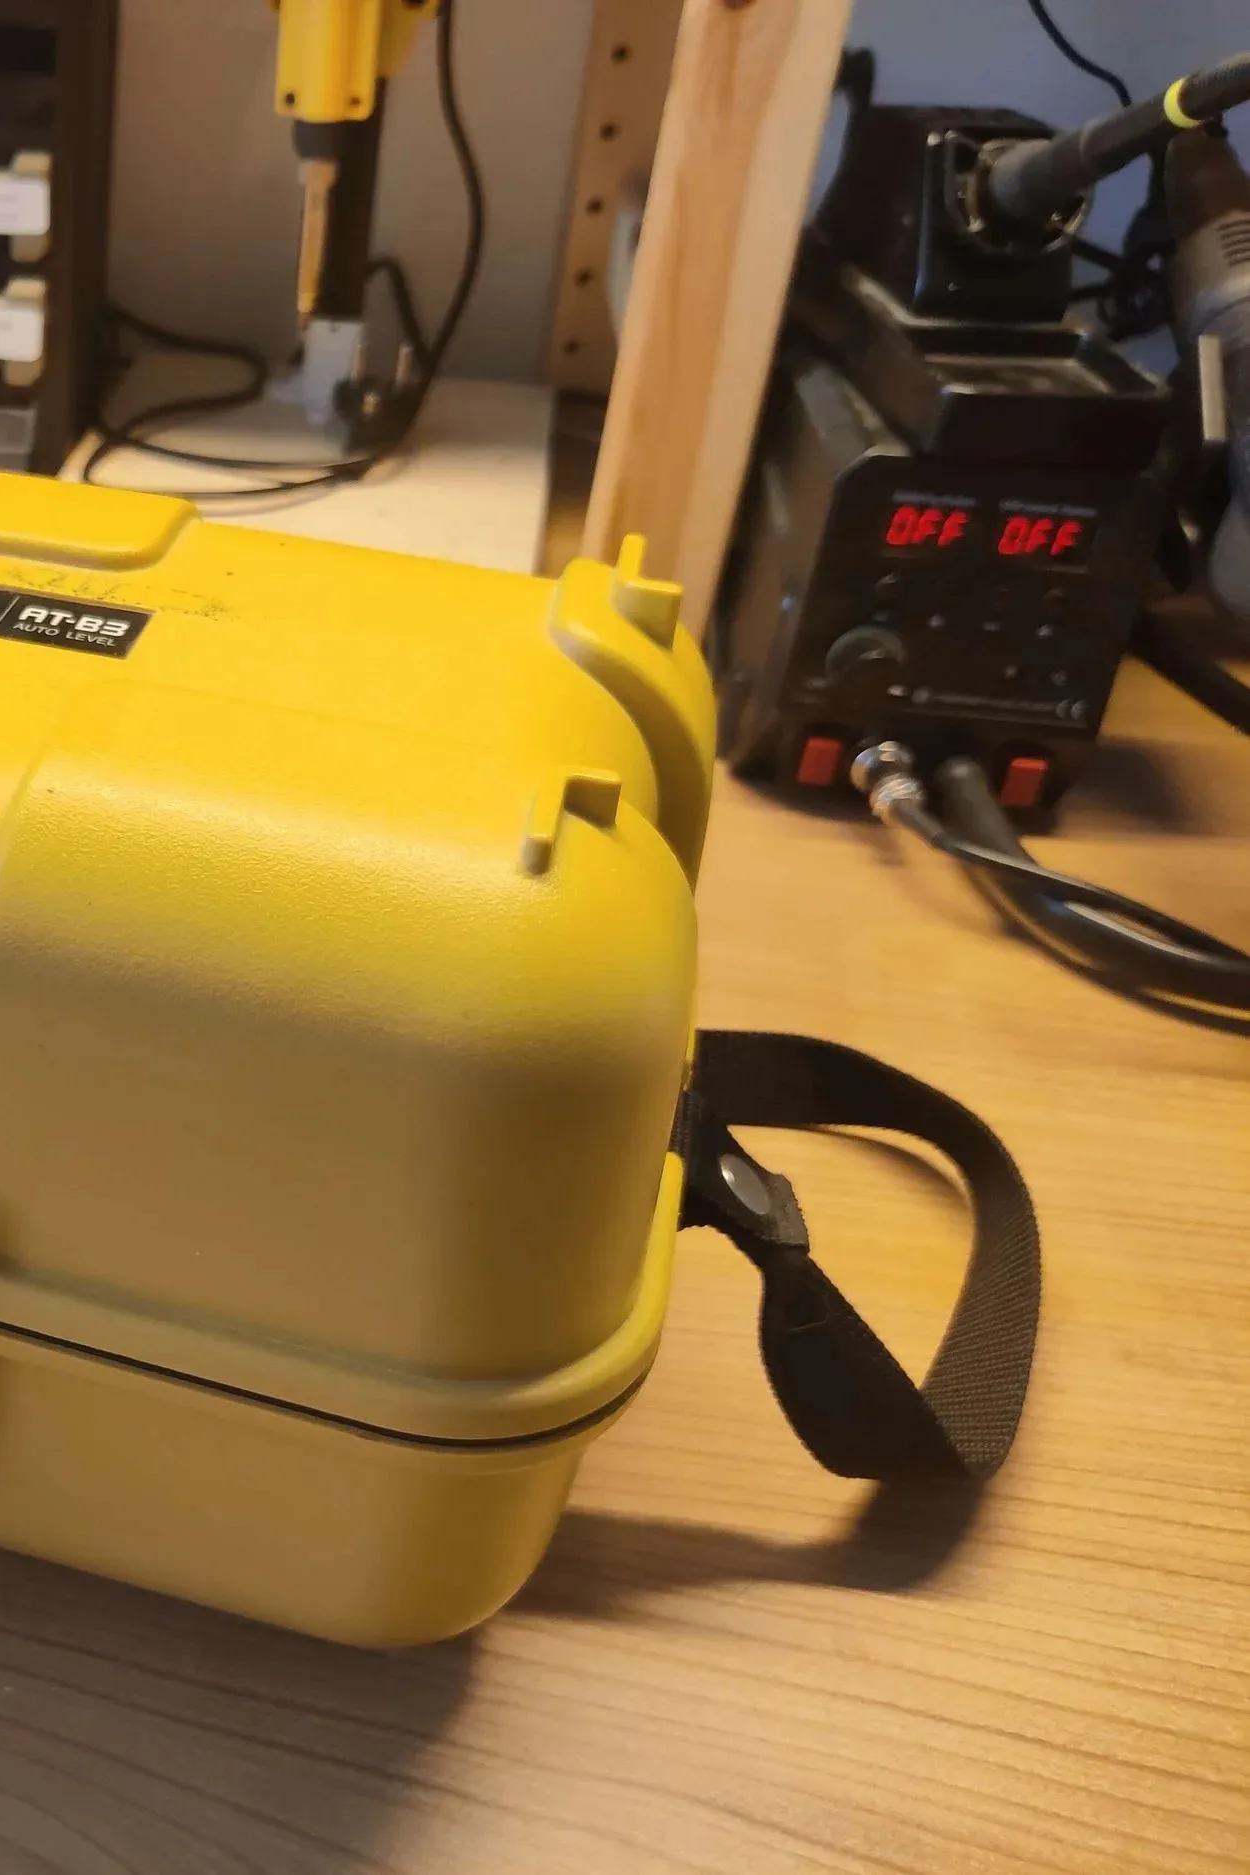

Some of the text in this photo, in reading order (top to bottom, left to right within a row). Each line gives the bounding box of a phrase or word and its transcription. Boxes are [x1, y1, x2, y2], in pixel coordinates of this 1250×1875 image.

[886, 504, 1082, 555] OFF OFF
[13, 621, 116, 647] AUTO LEVEL
[19, 606, 130, 637] AT-B3
